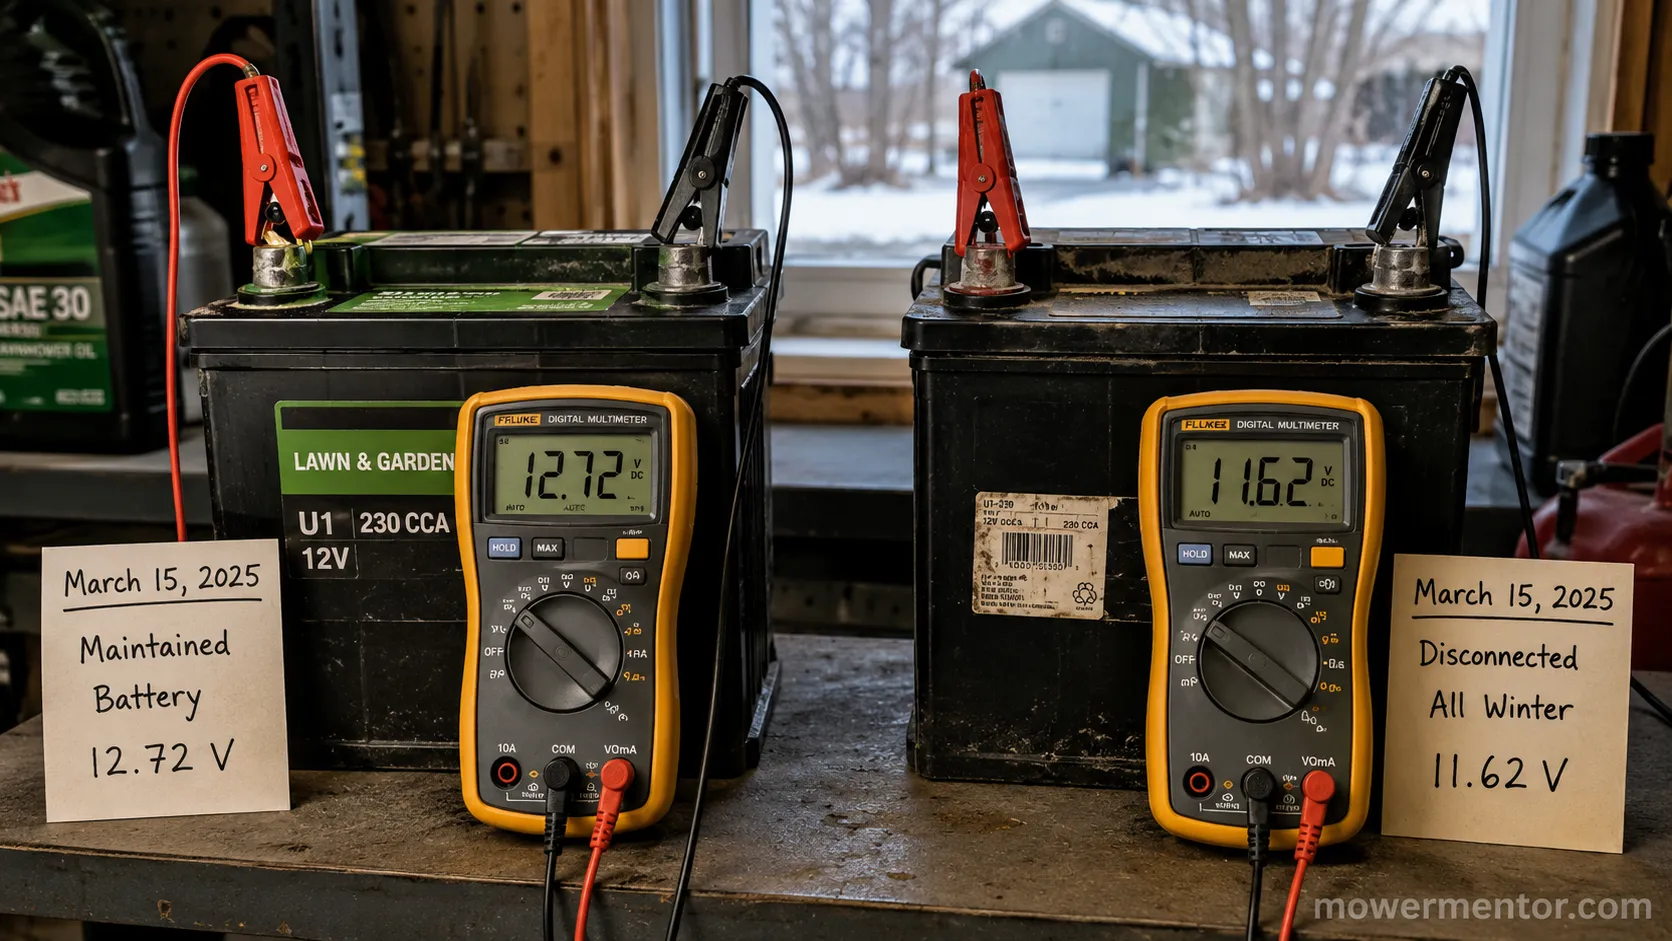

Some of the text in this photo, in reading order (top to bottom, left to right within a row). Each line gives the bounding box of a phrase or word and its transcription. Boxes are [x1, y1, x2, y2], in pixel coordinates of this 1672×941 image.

[52, 286, 91, 320] 30
[548, 415, 647, 423] DIGITAL MULTIMETER
[1237, 421, 1339, 430] DIGITAL MULTIMETER
[293, 452, 455, 471] LAWN & GARDEN
[634, 459, 641, 468] V
[524, 451, 623, 500] 12.72
[631, 471, 644, 480] DC
[1324, 466, 1333, 476] V
[1321, 478, 1335, 487] DC
[1189, 510, 1211, 518] AUTO
[299, 511, 450, 536] U1 230 CCA
[492, 543, 517, 553] HOLD
[536, 544, 558, 552] MAX
[302, 547, 350, 570] 12V
[1182, 549, 1208, 559] HOLD
[1229, 550, 1251, 559] MAX
[64, 563, 261, 598] March 15, 2025
[1414, 578, 1615, 614] March 15, 2025
[80, 628, 231, 665] Maintained
[484, 647, 504, 657] OFF
[1419, 639, 1579, 671] Disconnected
[1175, 655, 1195, 664] OFF
[93, 682, 202, 722] Battery
[1429, 690, 1574, 720] All Winter
[498, 743, 516, 753] 10A
[551, 745, 576, 754] COM
[91, 737, 235, 778] 12.72 V
[1190, 753, 1210, 763] 10A
[1246, 755, 1272, 765] COM
[1433, 753, 1569, 792] 11.62 V
